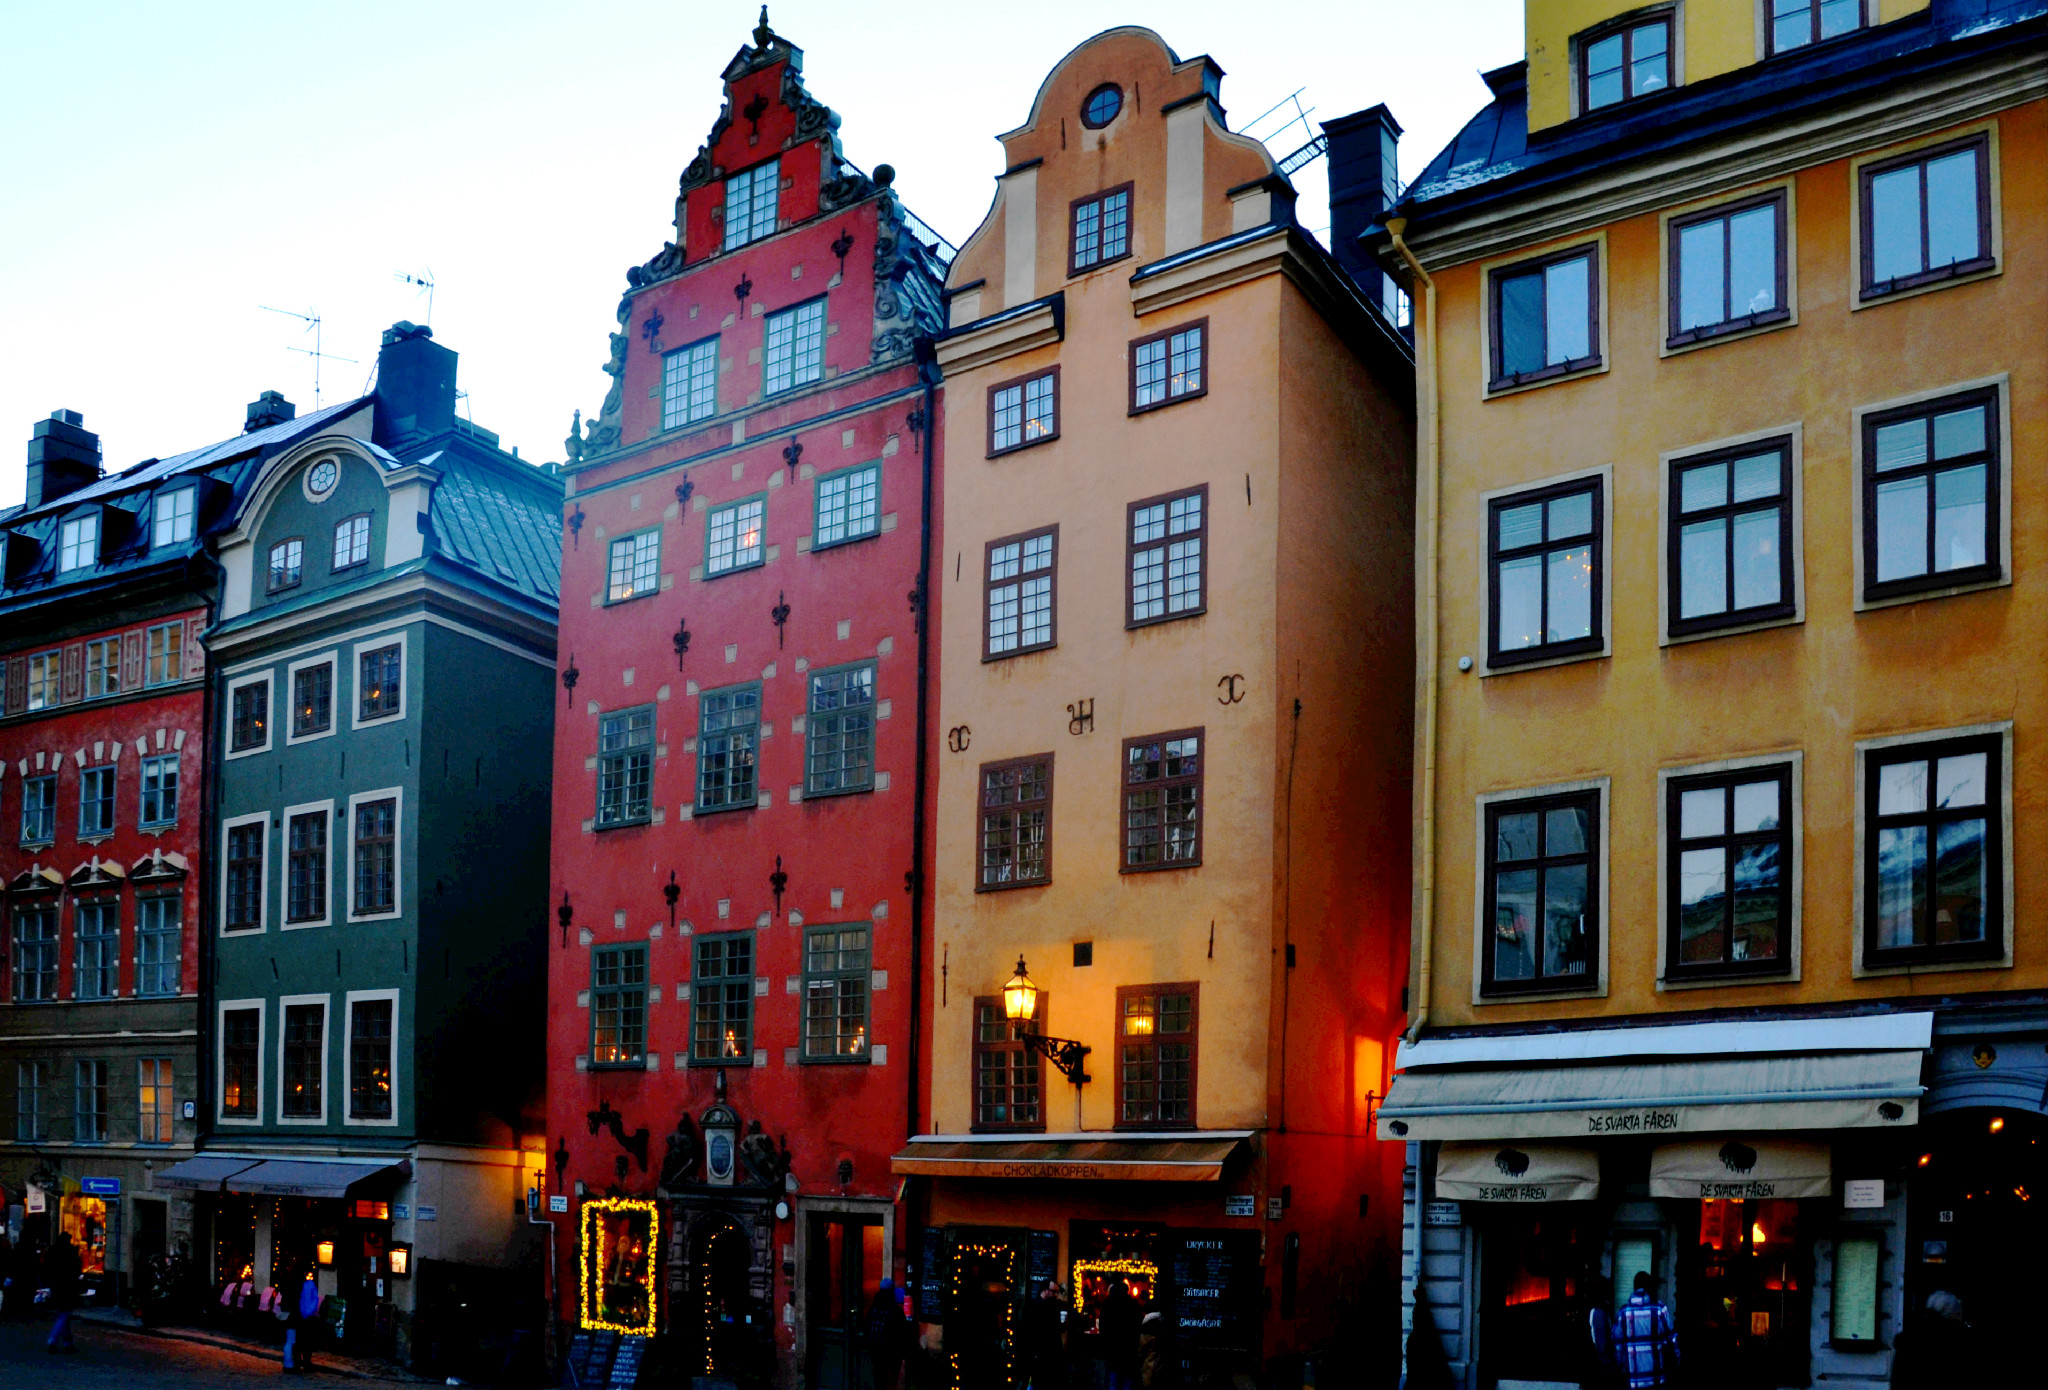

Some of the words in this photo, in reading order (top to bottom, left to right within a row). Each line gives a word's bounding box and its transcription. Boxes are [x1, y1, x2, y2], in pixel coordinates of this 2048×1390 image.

[1589, 1117, 1602, 1132] DE
[1605, 1115, 1640, 1131] SVARTA
[1644, 1111, 1678, 1131] FÅREN
[1003, 1165, 1098, 1178] CHOKLADKOPPEN
[1480, 1187, 1490, 1199] DE
[1491, 1187, 1517, 1200] SVARTA
[1521, 1185, 1546, 1200] FÅREN
[1701, 1183, 1711, 1197] DE
[1714, 1183, 1743, 1197] SVARTA
[1746, 1181, 1774, 1197] FÅREN
[1942, 1212, 1951, 1221] 16
